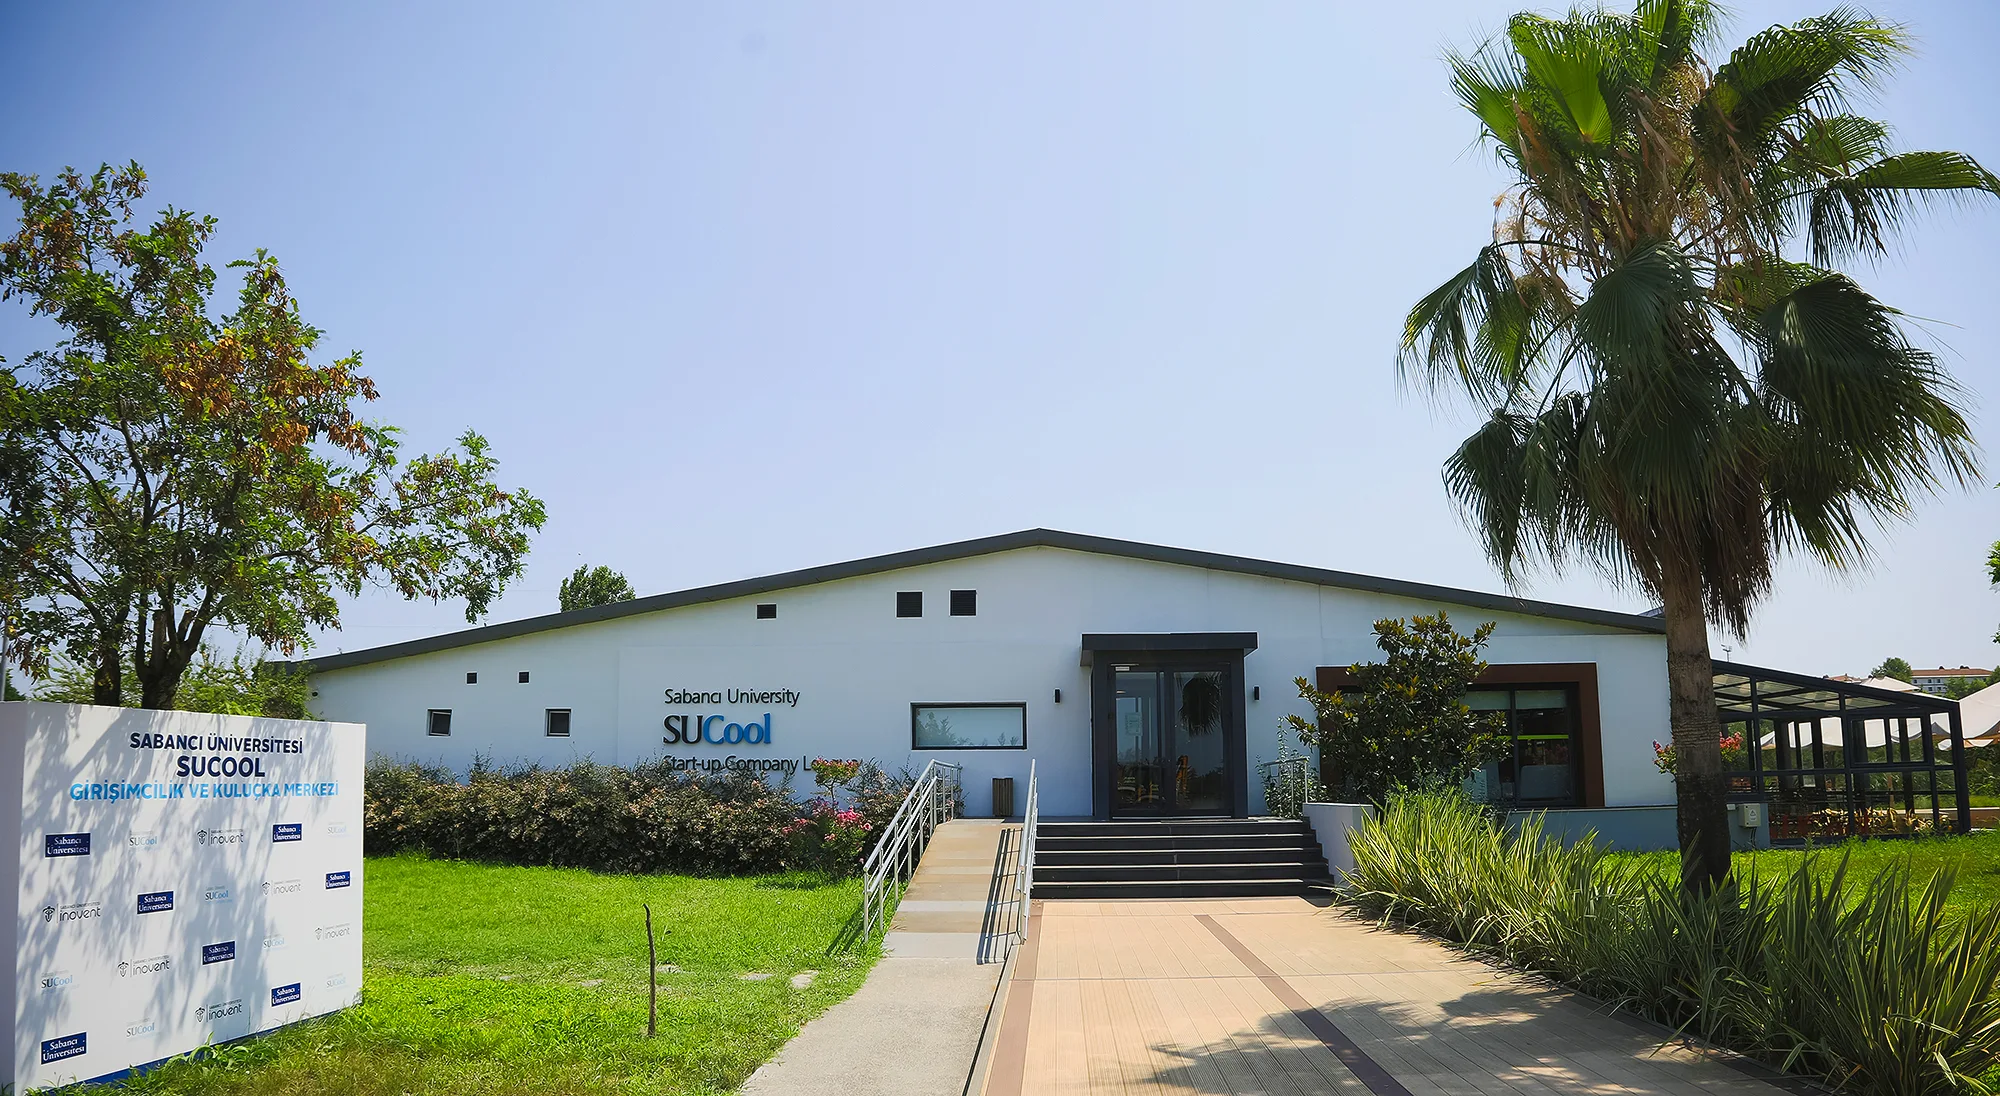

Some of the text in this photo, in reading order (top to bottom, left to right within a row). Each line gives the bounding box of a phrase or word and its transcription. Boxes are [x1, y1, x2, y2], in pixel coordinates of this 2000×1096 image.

[664, 687, 800, 708] Sabancı University
[662, 712, 772, 745] SUCool
[129, 732, 303, 754] SABANCI ÜNİVERSİTESİ
[176, 755, 266, 778] SUCOOL
[724, 755, 799, 775] Company
[69, 779, 339, 805] GİRİŞİMCİLİK VE KULUÇKA MERKEZİ
[210, 833, 244, 846] inovent
[59, 907, 101, 922] inovent
[132, 959, 170, 977] inovent
[41, 974, 73, 989] SUCool
[208, 1003, 243, 1021] inovent
[126, 1022, 155, 1038] SUCool
[49, 1038, 78, 1051] Sabancı
